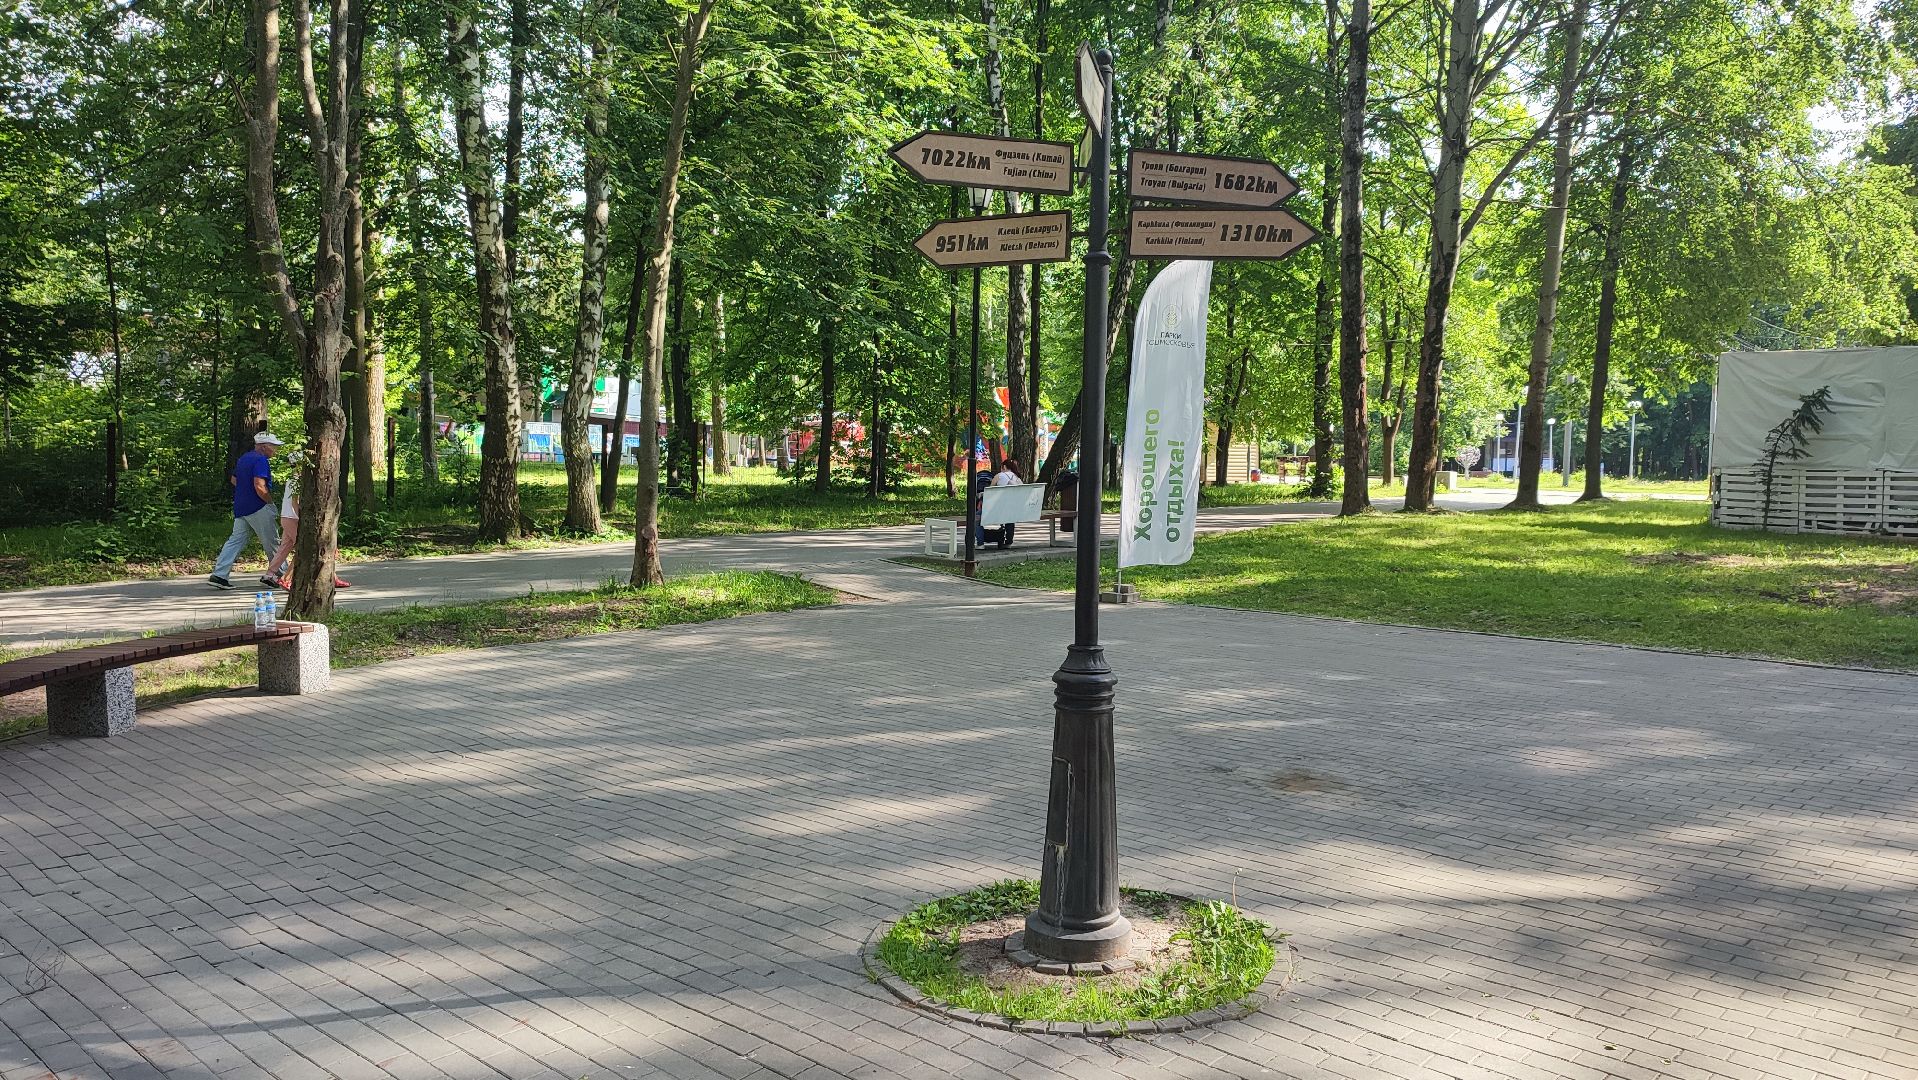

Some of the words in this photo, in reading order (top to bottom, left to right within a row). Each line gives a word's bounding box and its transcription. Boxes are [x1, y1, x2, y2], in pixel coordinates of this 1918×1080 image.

[1032, 152, 1065, 165] (Китай)
[1003, 166, 1027, 177] Fujian
[1029, 168, 1057, 181] (China)
[1141, 160, 1163, 172] Троян
[1165, 163, 1207, 176] (Болгария)
[1140, 177, 1166, 188] Troyan
[1167, 179, 1206, 193] (Bulgaria)
[1021, 223, 1063, 236] (Беларусь)
[999, 242, 1023, 251] Kletsk
[1025, 239, 1059, 251] (Belarus)
[1174, 237, 1206, 246] (Finland)
[1133, 409, 1160, 542] Хорошего
[1166, 440, 1185, 543] отдыха!
